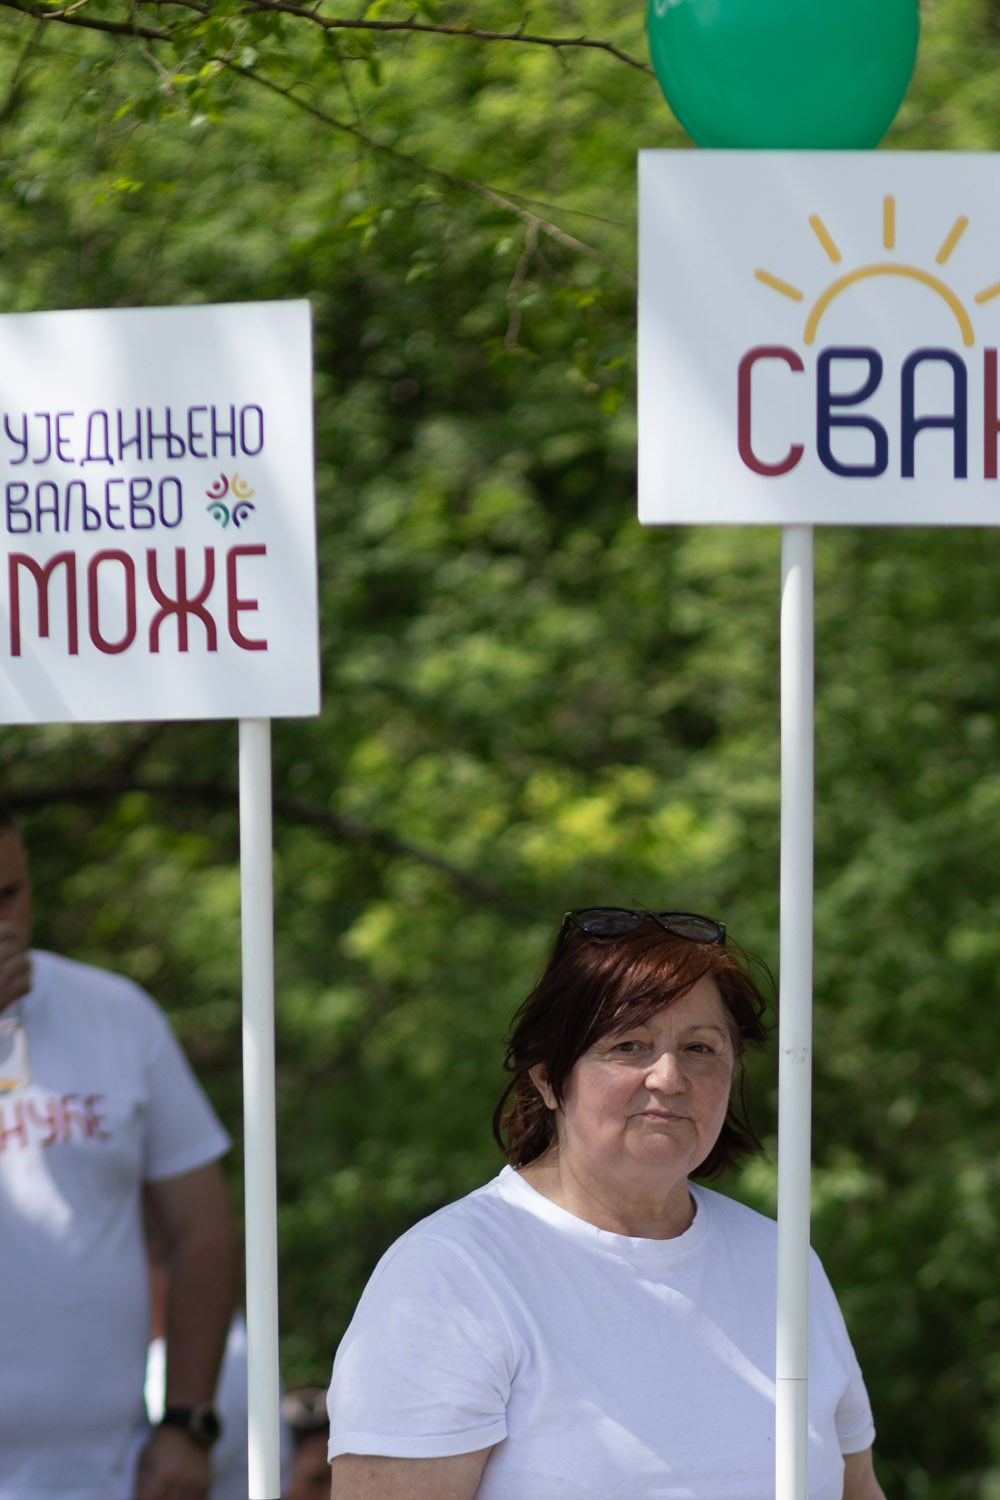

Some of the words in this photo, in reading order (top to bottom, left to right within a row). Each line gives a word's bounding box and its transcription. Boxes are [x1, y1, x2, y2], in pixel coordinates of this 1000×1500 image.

[3, 403, 265, 467] УЈЕДИЊЕНО
[5, 476, 184, 535] ВАЉЕВО
[7, 543, 269, 658] МОЖЕ
